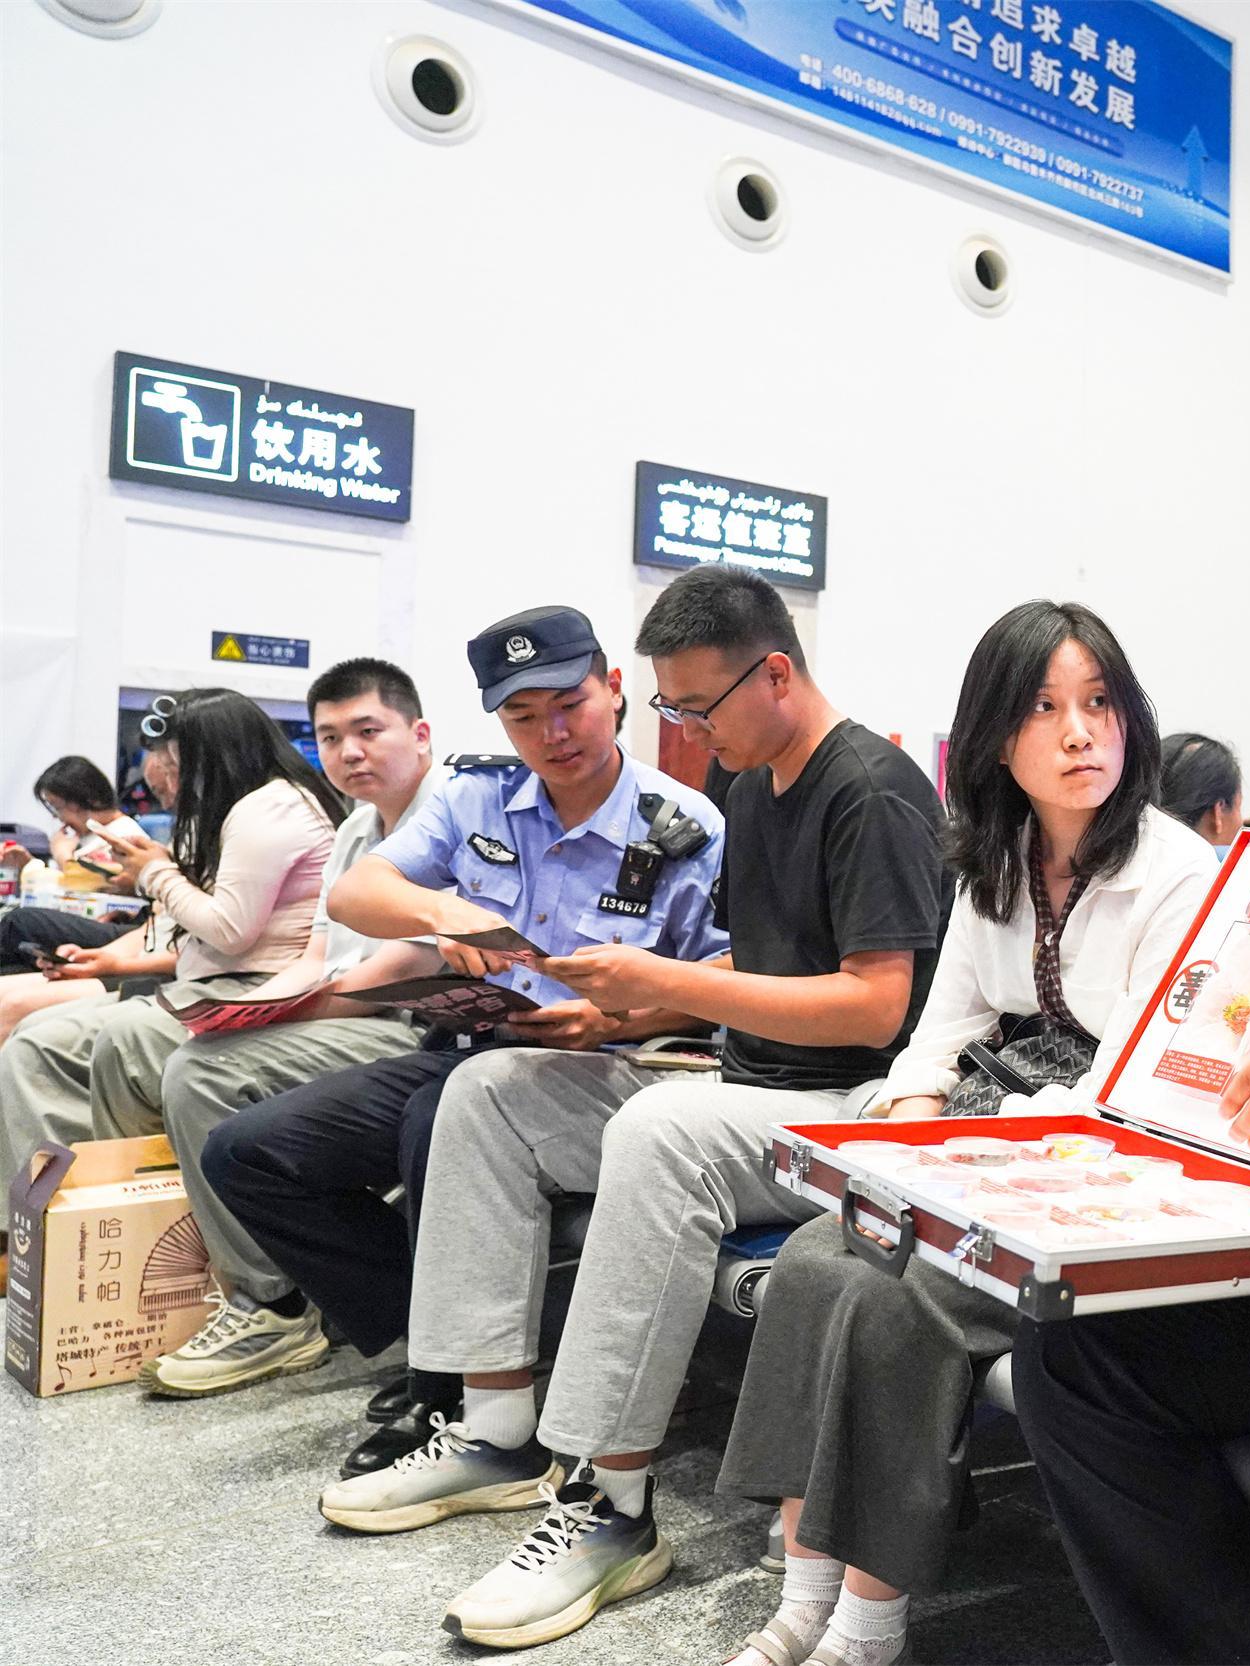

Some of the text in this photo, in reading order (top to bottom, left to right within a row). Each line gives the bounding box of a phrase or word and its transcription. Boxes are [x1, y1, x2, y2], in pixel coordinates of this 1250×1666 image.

[957, 0, 1136, 84] 追求卓越
[251, 418, 383, 476] 饮用水
[250, 462, 401, 504] Drinking Water
[601, 896, 648, 914] 134678
[97, 1217, 122, 1302] 哈力帕
